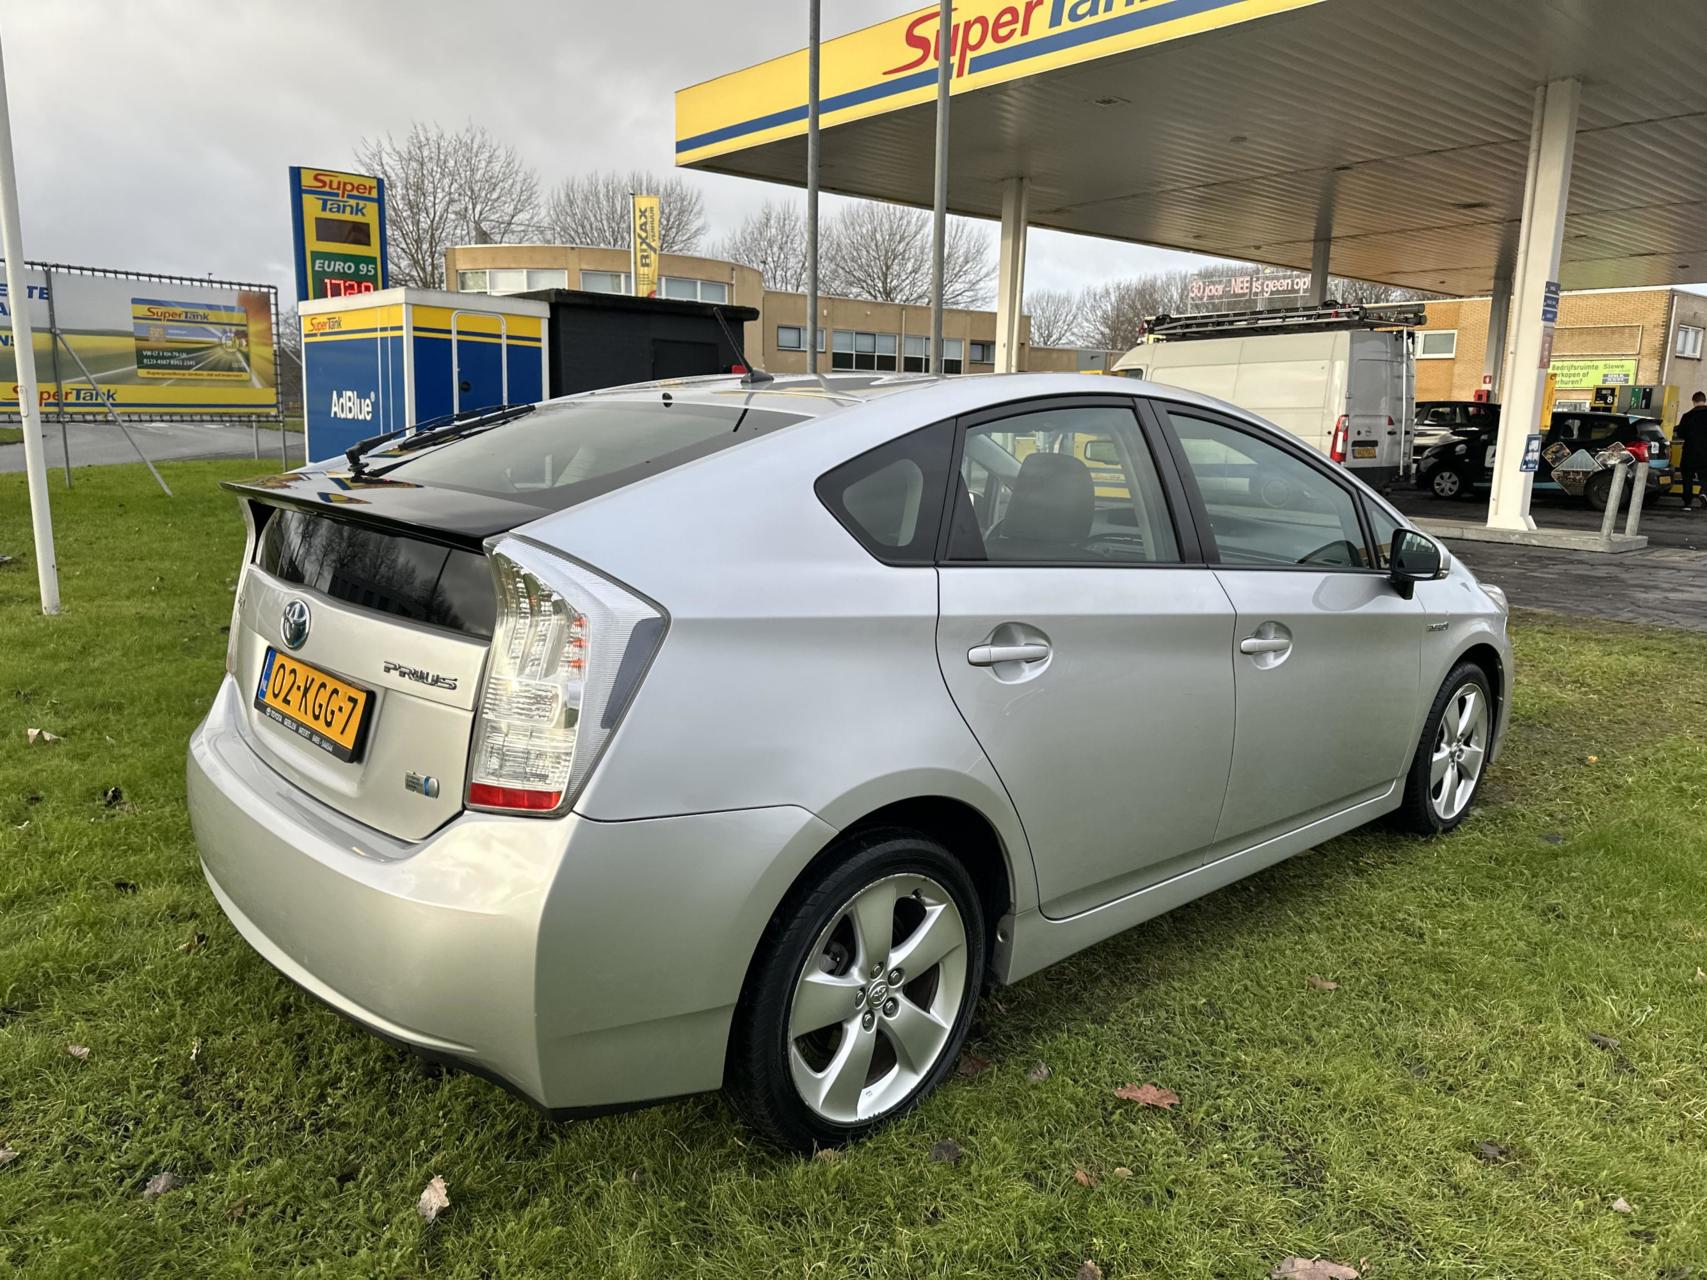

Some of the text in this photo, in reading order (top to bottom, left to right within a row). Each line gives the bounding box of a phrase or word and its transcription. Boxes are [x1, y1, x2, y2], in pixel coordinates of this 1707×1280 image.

[302, 172, 376, 198] Super
[314, 197, 367, 217] Tank
[314, 259, 376, 276] EURO 95
[1190, 281, 1203, 297] 30
[1203, 282, 1225, 302] jaar
[1231, 277, 1250, 294] NEE
[1252, 277, 1262, 293] is
[1263, 279, 1292, 297] geen
[143, 306, 209, 322] SuperTank
[308, 316, 342, 332] SuperTank
[1551, 363, 1599, 372] Bedrijfsruimte
[2, 384, 117, 406] SperTank
[1606, 395, 1613, 404] 8
[384, 660, 458, 690] PRIUS
[272, 662, 359, 736] 02-KGG-7
